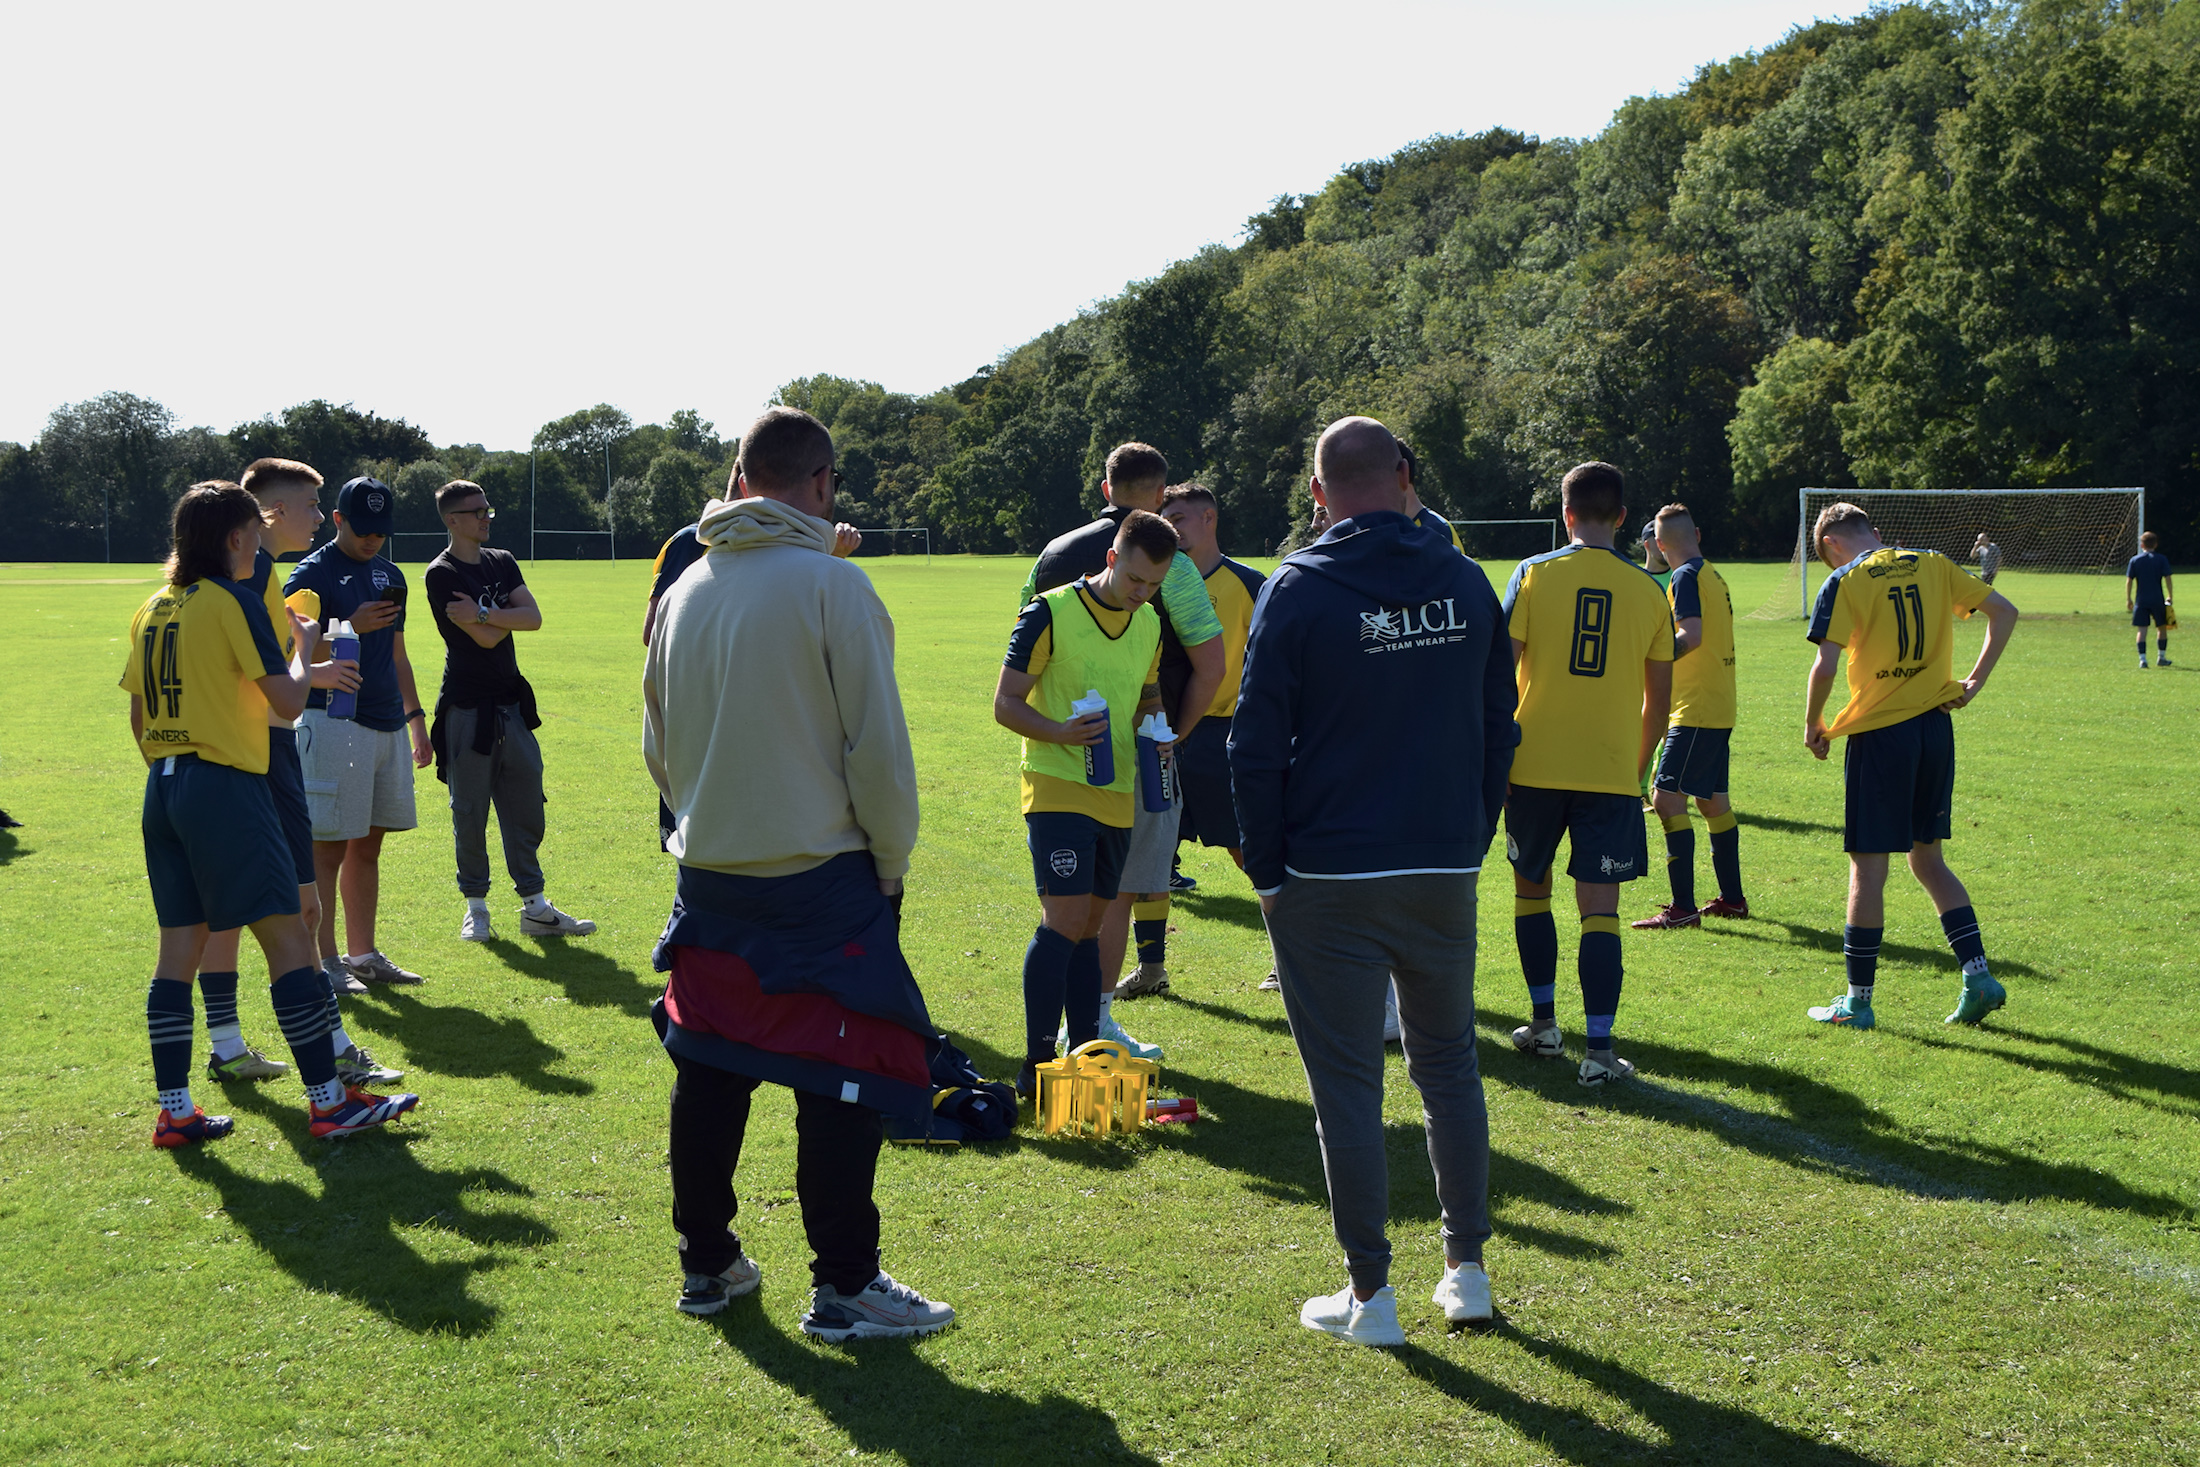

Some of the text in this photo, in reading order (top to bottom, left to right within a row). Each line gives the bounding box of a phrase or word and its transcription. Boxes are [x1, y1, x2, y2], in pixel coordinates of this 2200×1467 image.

[1402, 598, 1467, 636] LCL
[1569, 587, 1612, 678] 8
[1888, 584, 1925, 662] 11
[1385, 636, 1446, 652] TEAM WEAR
[144, 622, 182, 719] 14
[1084, 745, 1094, 777] AND
[1160, 756, 1170, 800] ILAND
